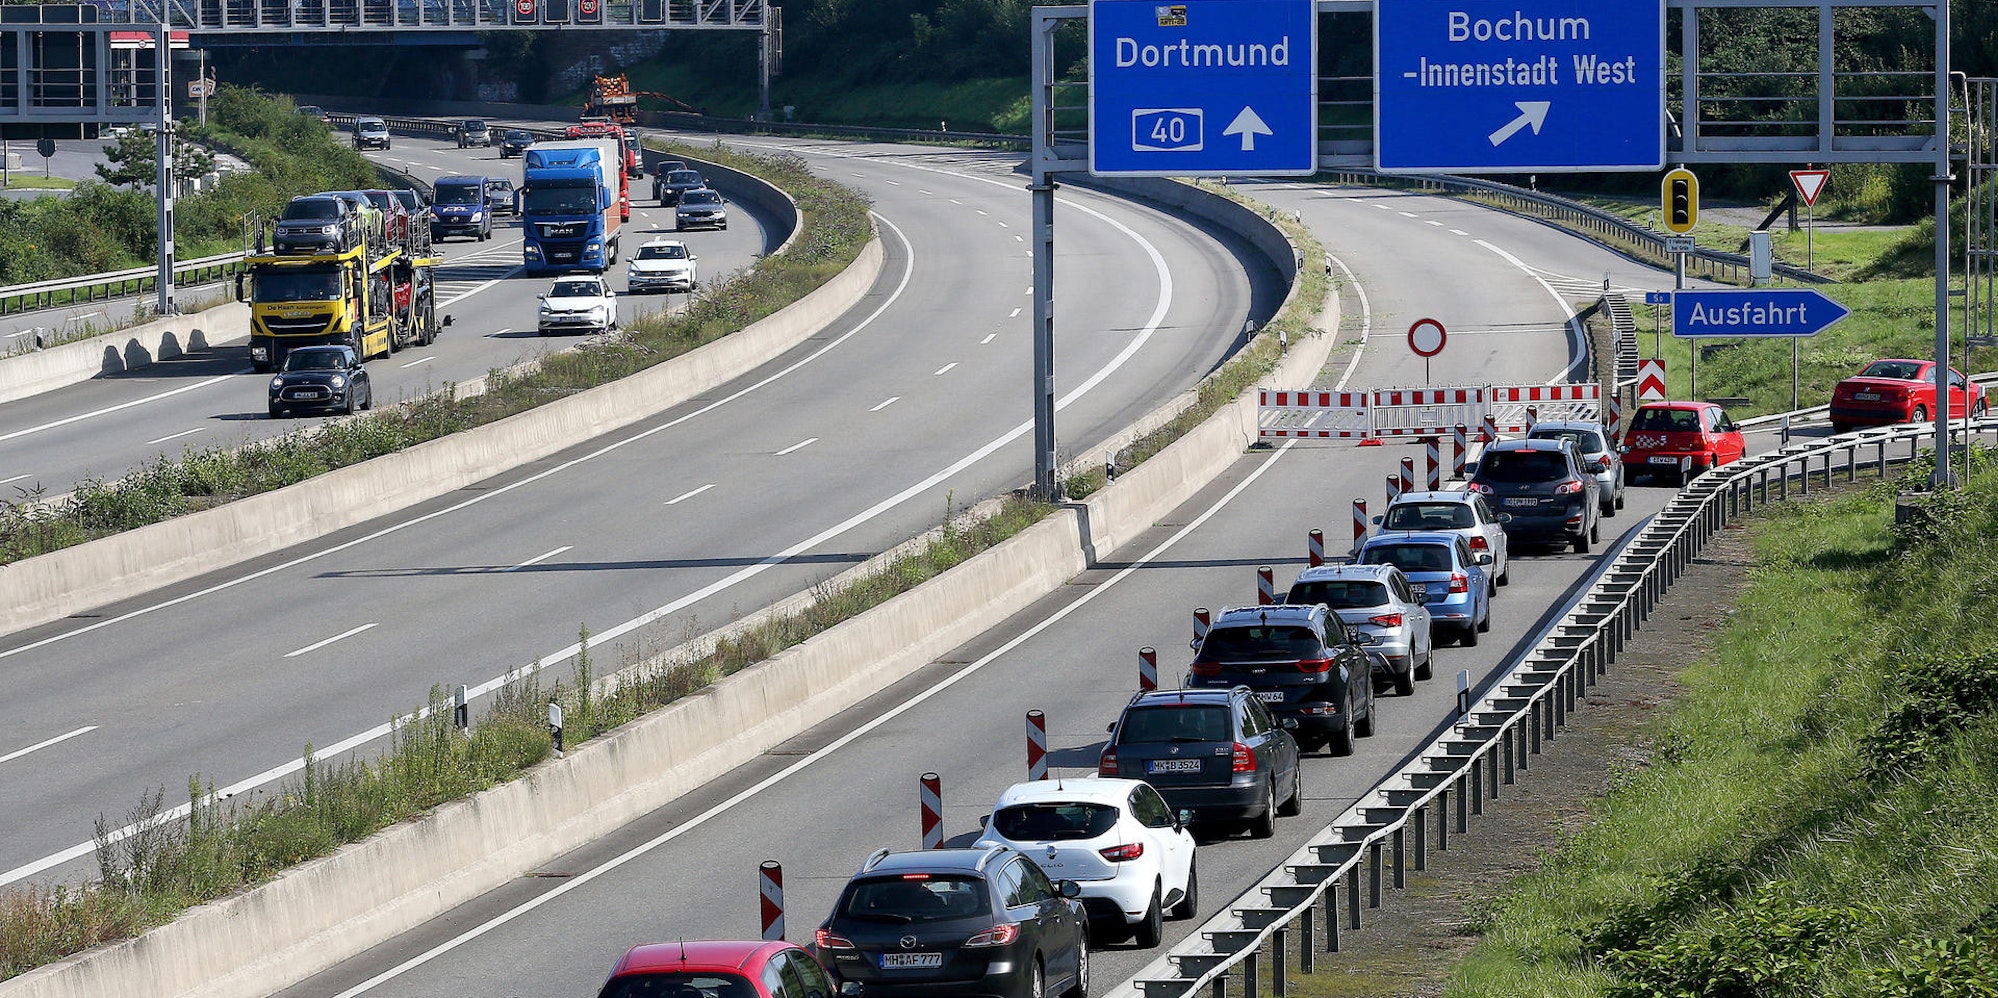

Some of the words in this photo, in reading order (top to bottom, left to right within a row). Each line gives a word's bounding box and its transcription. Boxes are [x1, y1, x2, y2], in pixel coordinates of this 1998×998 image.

[1448, 10, 1591, 42] Bochum
[1115, 35, 1290, 68] Dortmund
[1403, 54, 1559, 87] -Innenstadt
[1572, 54, 1637, 86] West
[1150, 116, 1186, 143] 40
[1688, 301, 1808, 326] Ausfahrt
[1273, 692, 1284, 701] 64
[1178, 760, 1200, 770] 3524
[884, 954, 899, 965] MH
[903, 954, 918, 965] AF
[920, 953, 941, 965] 777
